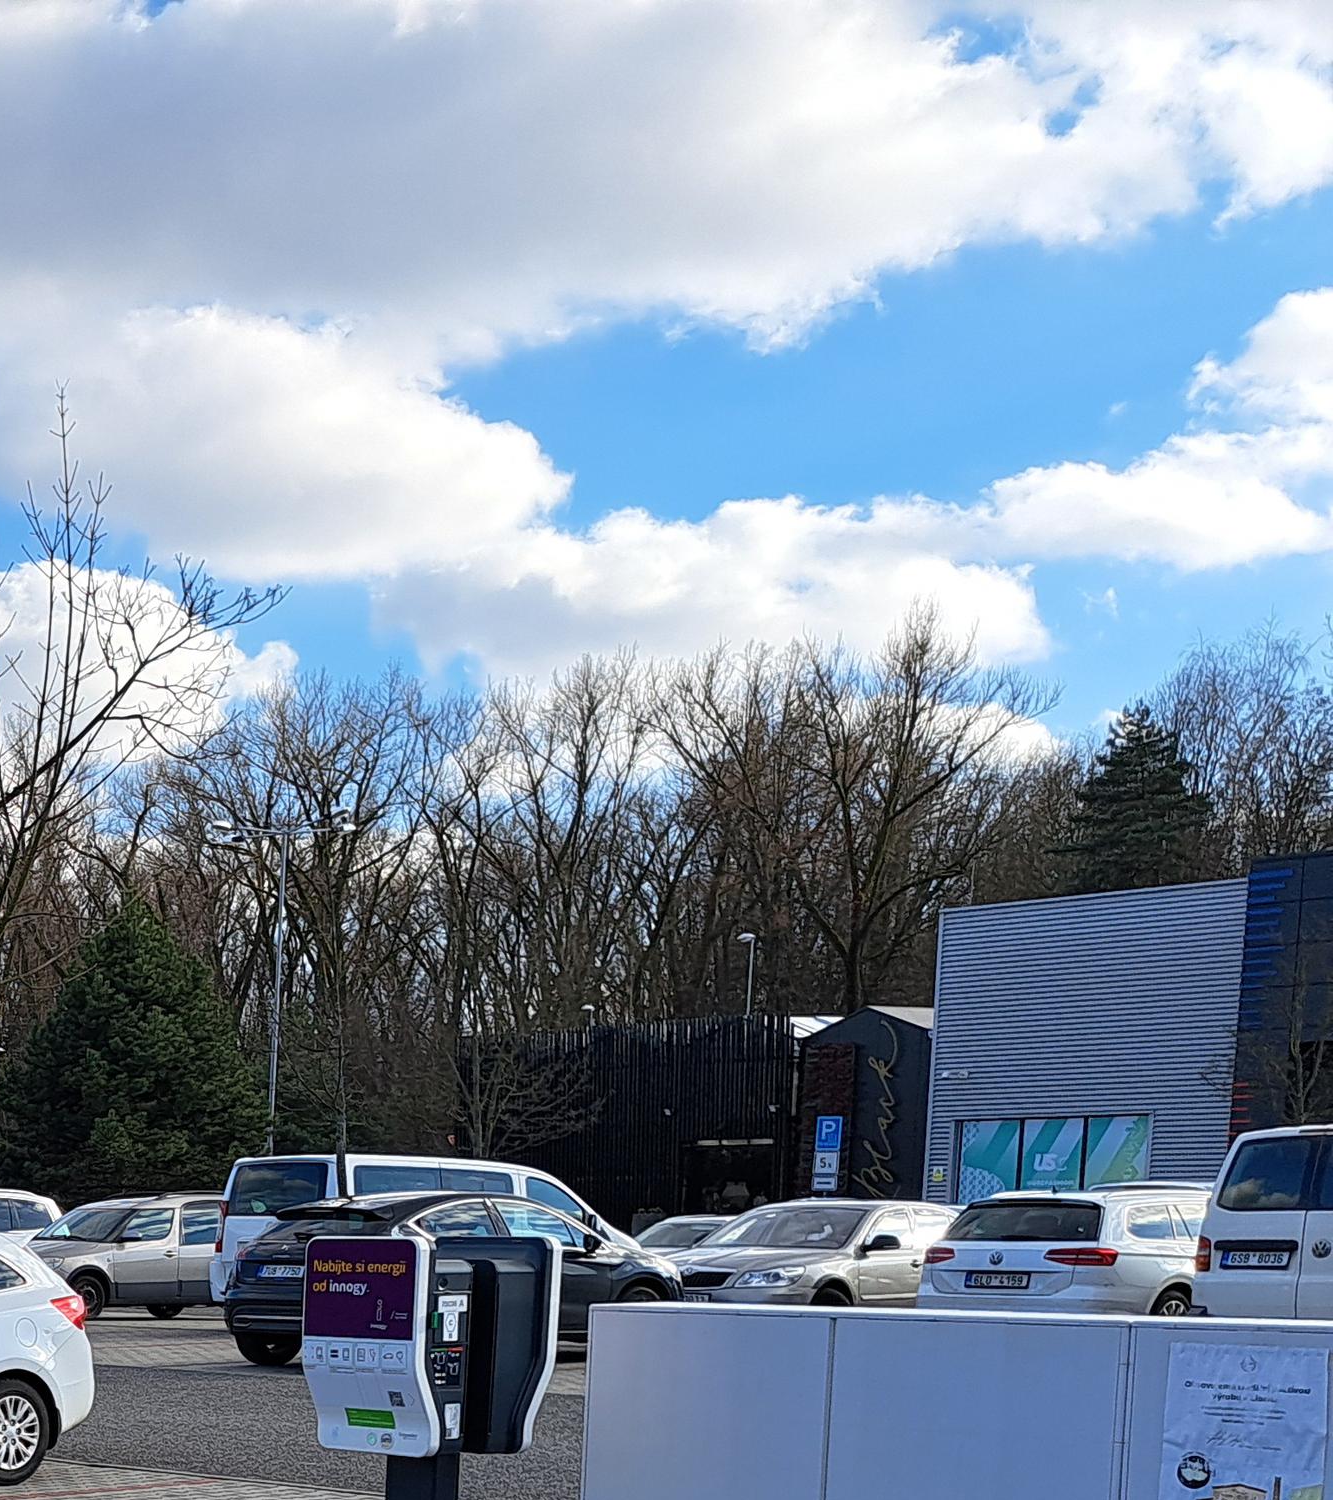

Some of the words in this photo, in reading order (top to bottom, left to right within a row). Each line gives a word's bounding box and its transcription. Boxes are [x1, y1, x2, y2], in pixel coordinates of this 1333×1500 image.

[822, 1120, 836, 1140] P
[313, 1260, 353, 1275] Nabijte
[355, 1260, 365, 1273] si
[367, 1260, 406, 1275] energii
[313, 1280, 327, 1292] od
